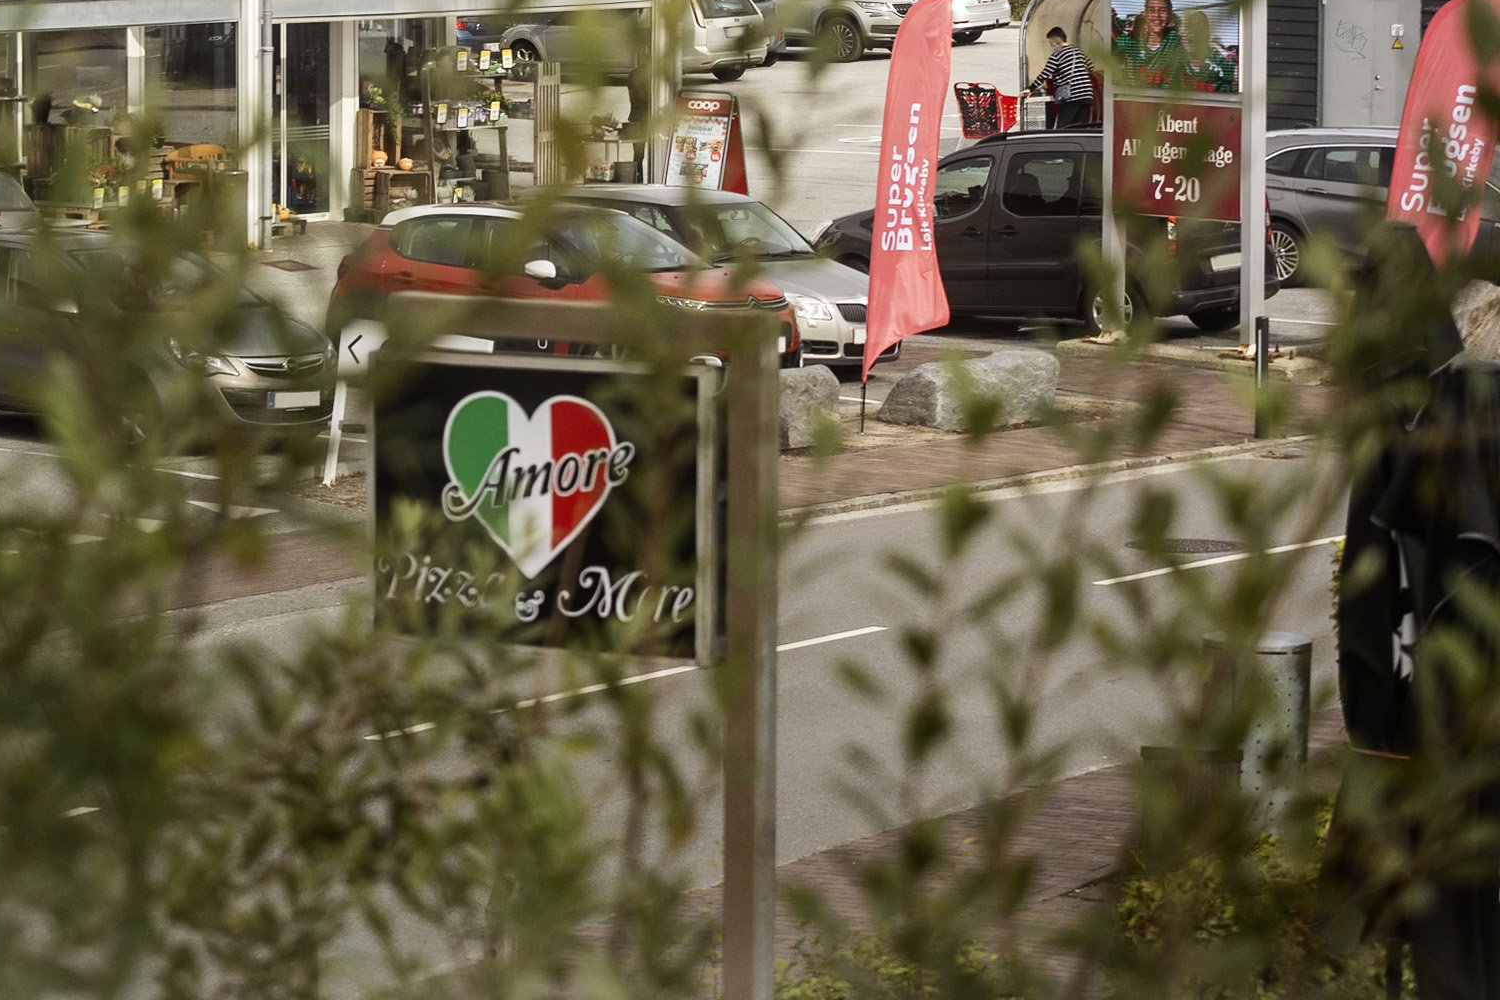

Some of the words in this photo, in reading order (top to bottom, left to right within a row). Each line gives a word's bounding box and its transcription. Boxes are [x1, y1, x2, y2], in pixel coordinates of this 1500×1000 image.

[687, 100, 720, 112] coop
[1156, 110, 1198, 134] Åbent
[1153, 142, 1190, 164] ugen
[1204, 145, 1233, 168] age
[1426, 84, 1477, 216] ugsen
[895, 103, 922, 251] Brugsen
[1152, 173, 1200, 203] 7-20
[881, 146, 903, 251] Super
[442, 440, 635, 522] Amore
[515, 590, 545, 622] &
